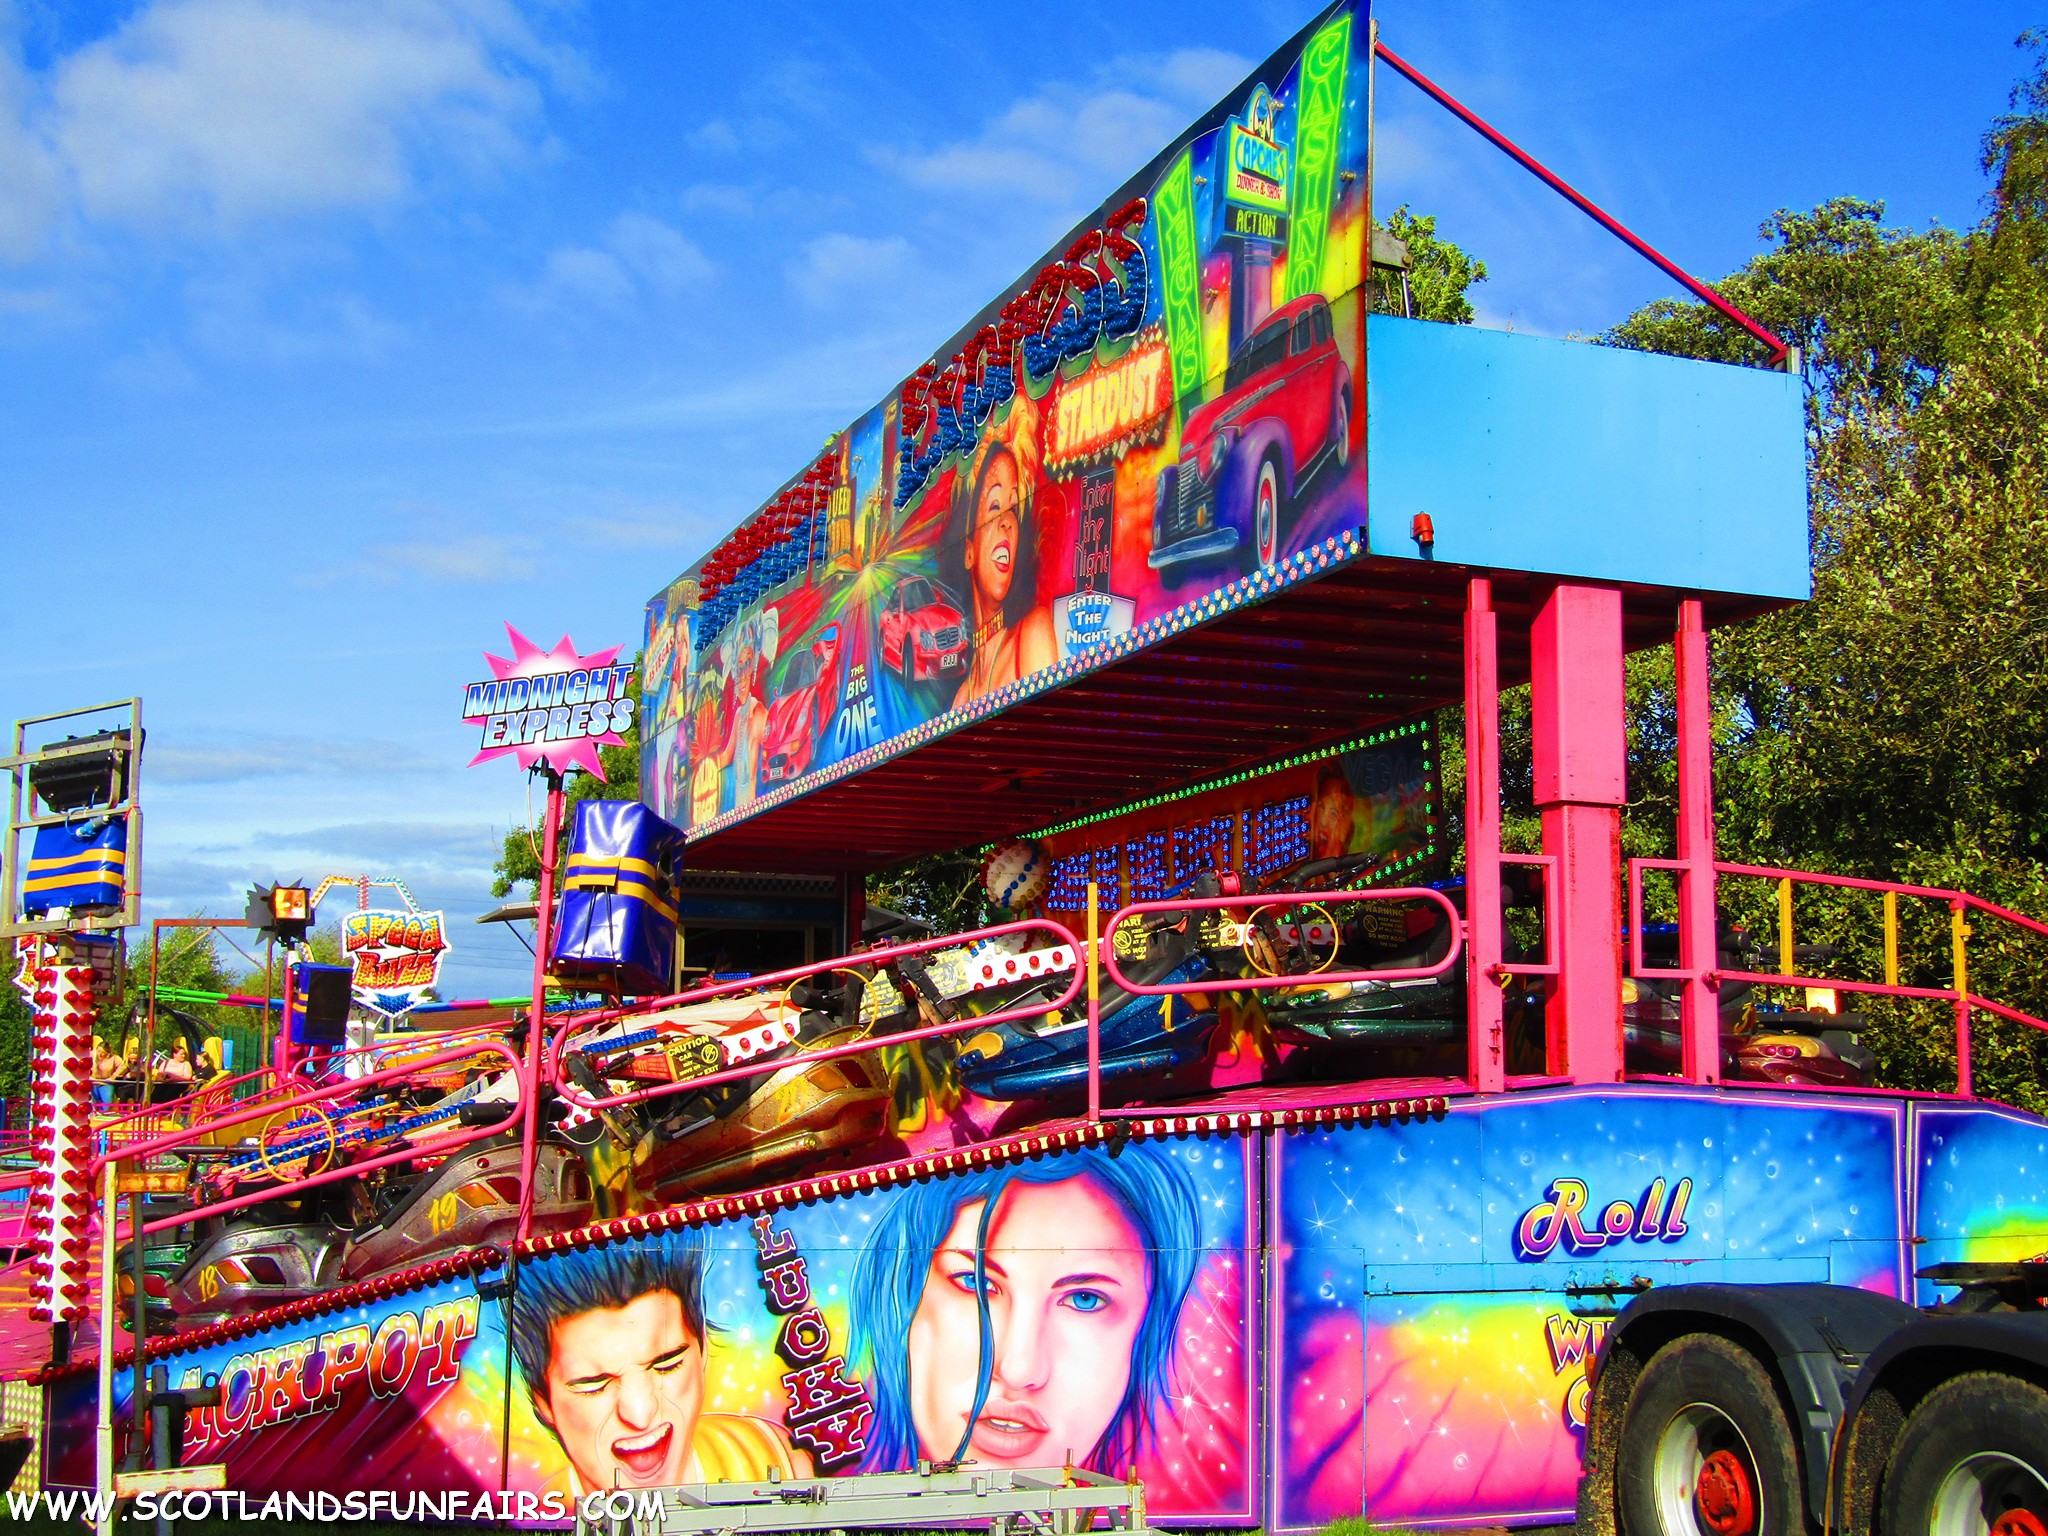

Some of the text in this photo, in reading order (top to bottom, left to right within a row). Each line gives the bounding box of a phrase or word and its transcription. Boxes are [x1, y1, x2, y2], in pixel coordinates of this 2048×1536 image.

[1290, 30, 1343, 297] CASINO
[1235, 209, 1278, 238] ACTION
[1159, 163, 1198, 389] VEGAS
[1056, 350, 1163, 452] STARDUST
[1066, 594, 1112, 613] ENTER
[1074, 610, 1102, 626] THE
[1065, 629, 1111, 644] NIGHT
[845, 675, 868, 700] BIG
[850, 663, 865, 678] THE
[463, 663, 636, 719] MIDNIGHT
[480, 698, 636, 750] EXPRESS
[834, 694, 885, 762] ONE
[1364, 904, 1405, 916] WARNING
[667, 1034, 710, 1057] CAUTION
[678, 1052, 693, 1062] CAR
[703, 1064, 719, 1075] EXIT
[427, 1191, 457, 1236] 19
[1517, 1176, 1694, 1257] Roll
[198, 1265, 219, 1302] 18
[752, 1213, 874, 1467] LUCKY
[130, 1294, 481, 1455] ACKPOT
